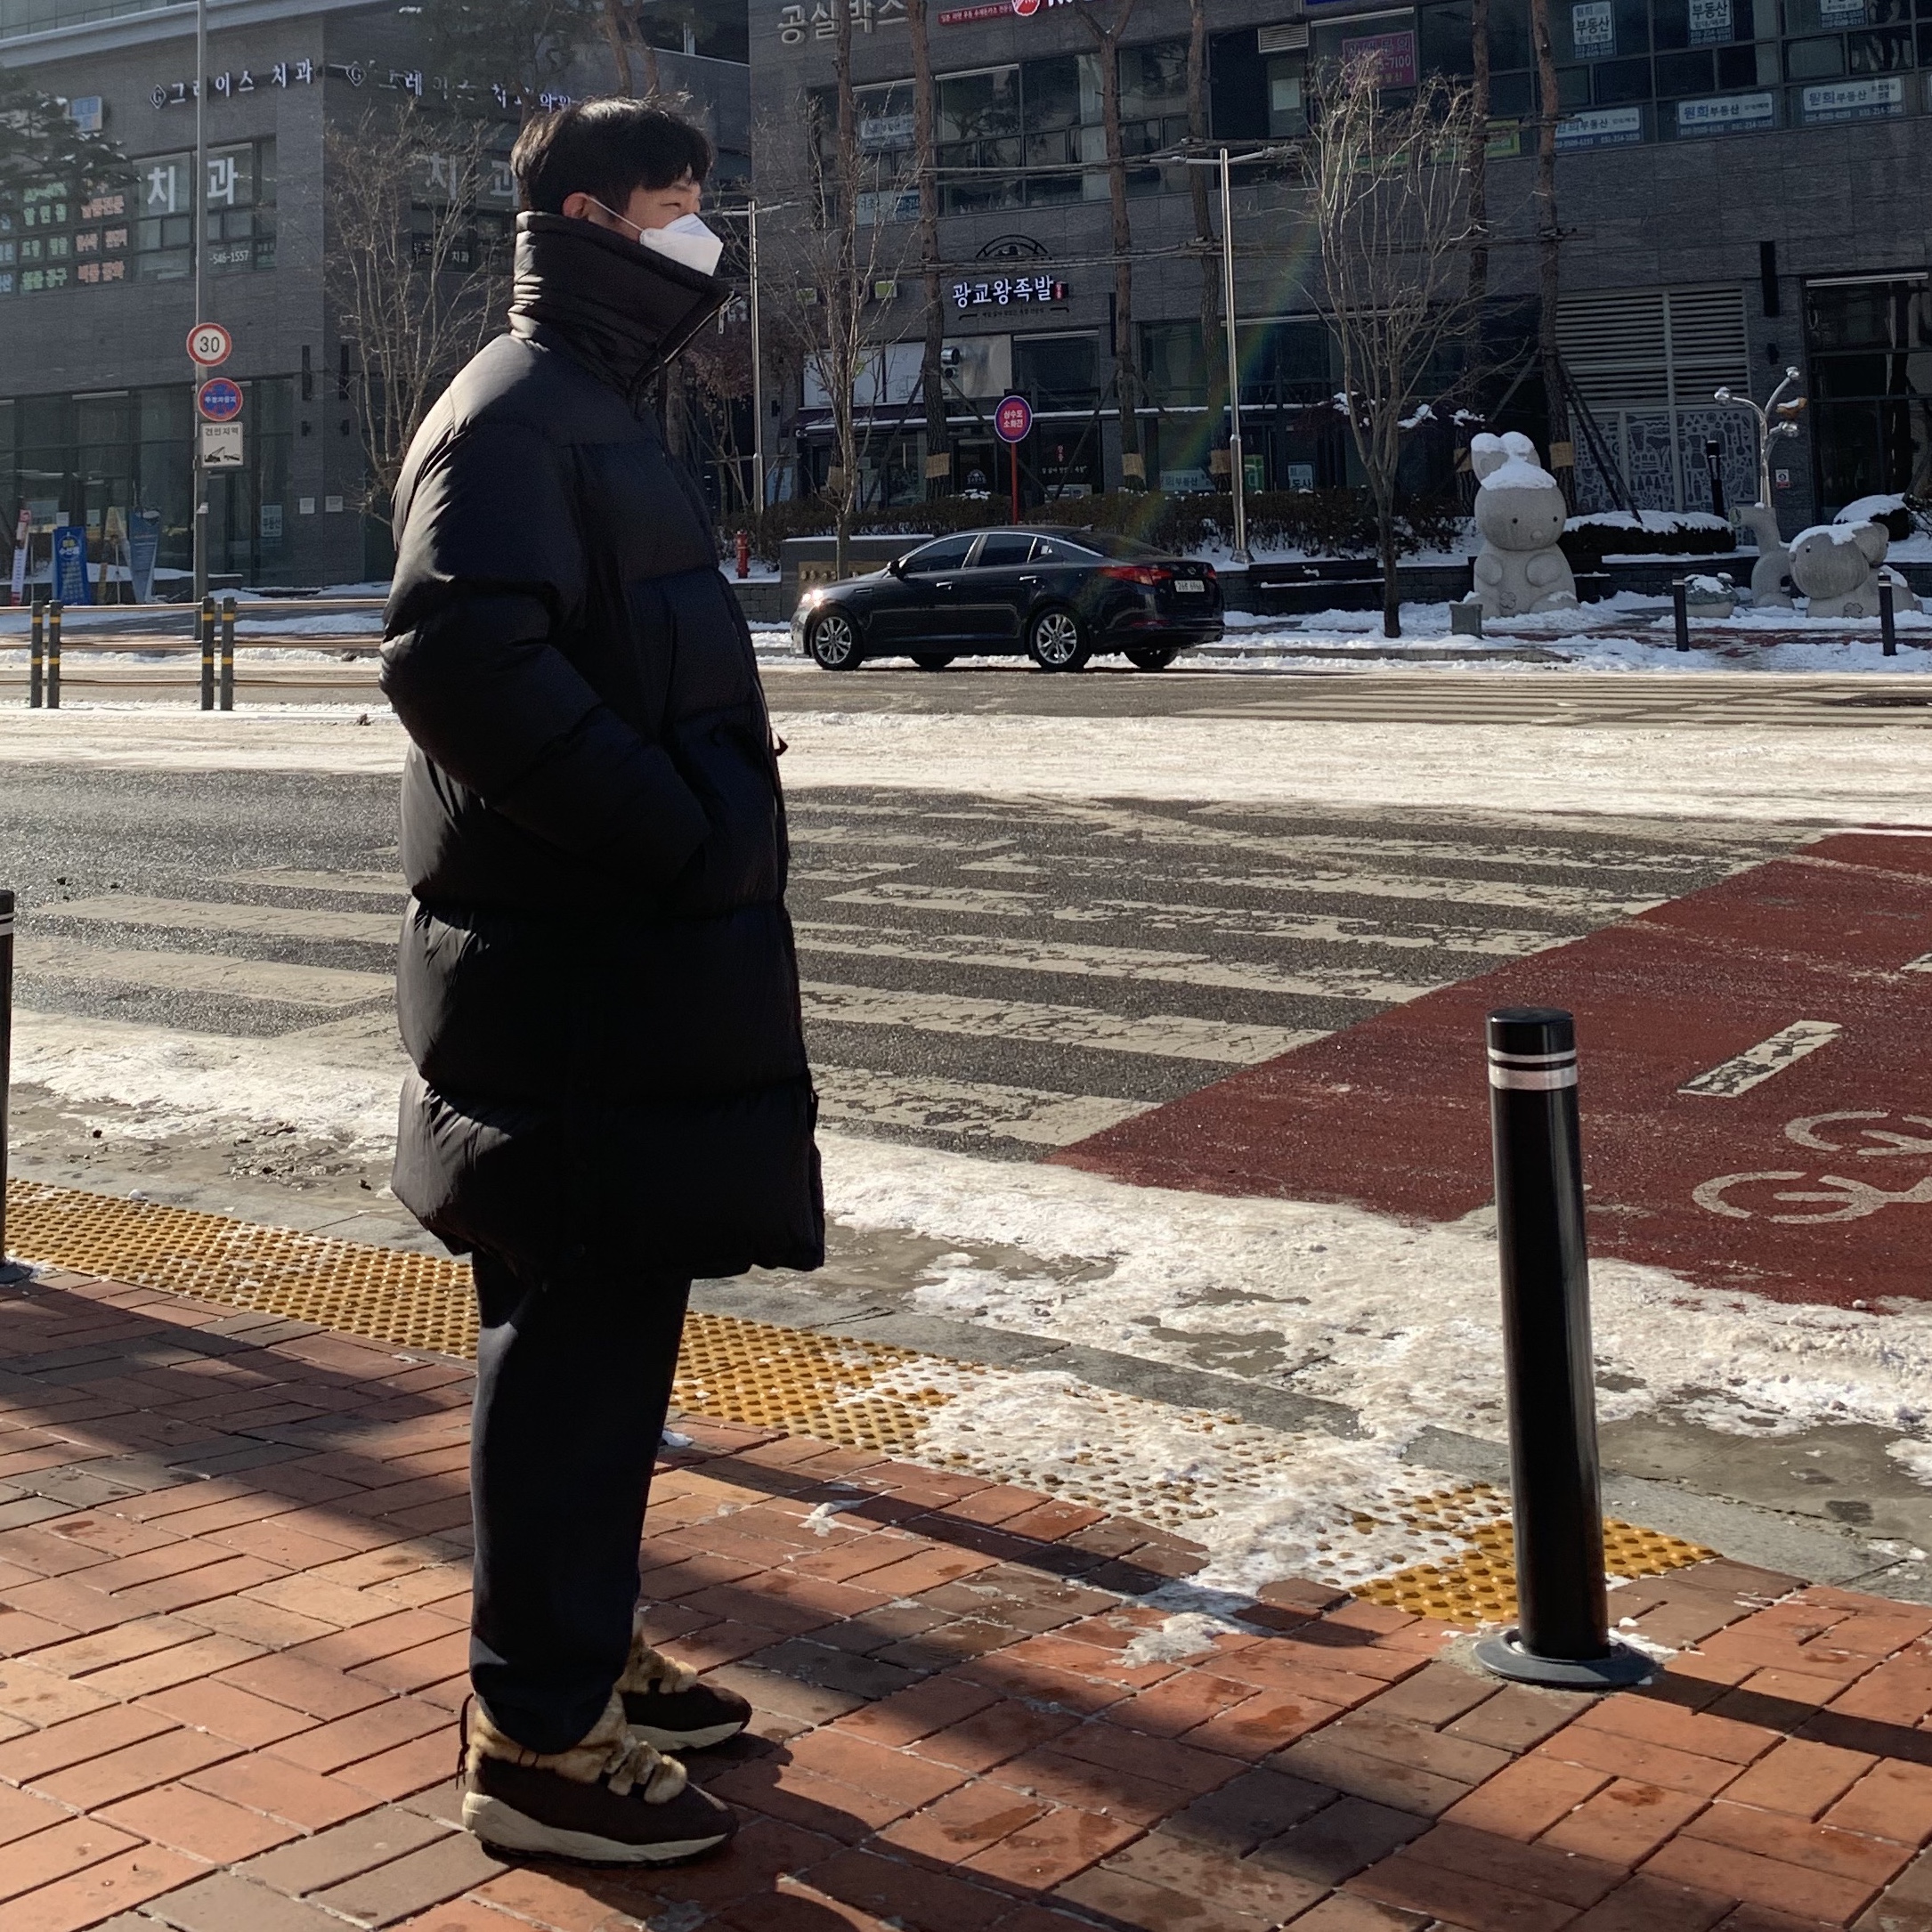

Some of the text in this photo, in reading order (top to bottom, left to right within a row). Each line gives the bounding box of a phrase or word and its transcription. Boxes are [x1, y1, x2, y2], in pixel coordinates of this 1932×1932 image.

[1693, 0, 1727, 20] 부동산
[1576, 15, 1610, 35] 부동산
[272, 58, 313, 89] 치과
[148, 157, 239, 214] 치과
[426, 151, 520, 207] 치과
[451, 250, 470, 263] 치과
[953, 276, 1055, 308] 광교왕족발
[199, 336, 221, 353] 30
[1003, 410, 1023, 419] 상수도
[1003, 419, 1023, 428] 소화전
[205, 426, 239, 436] 견인지역
